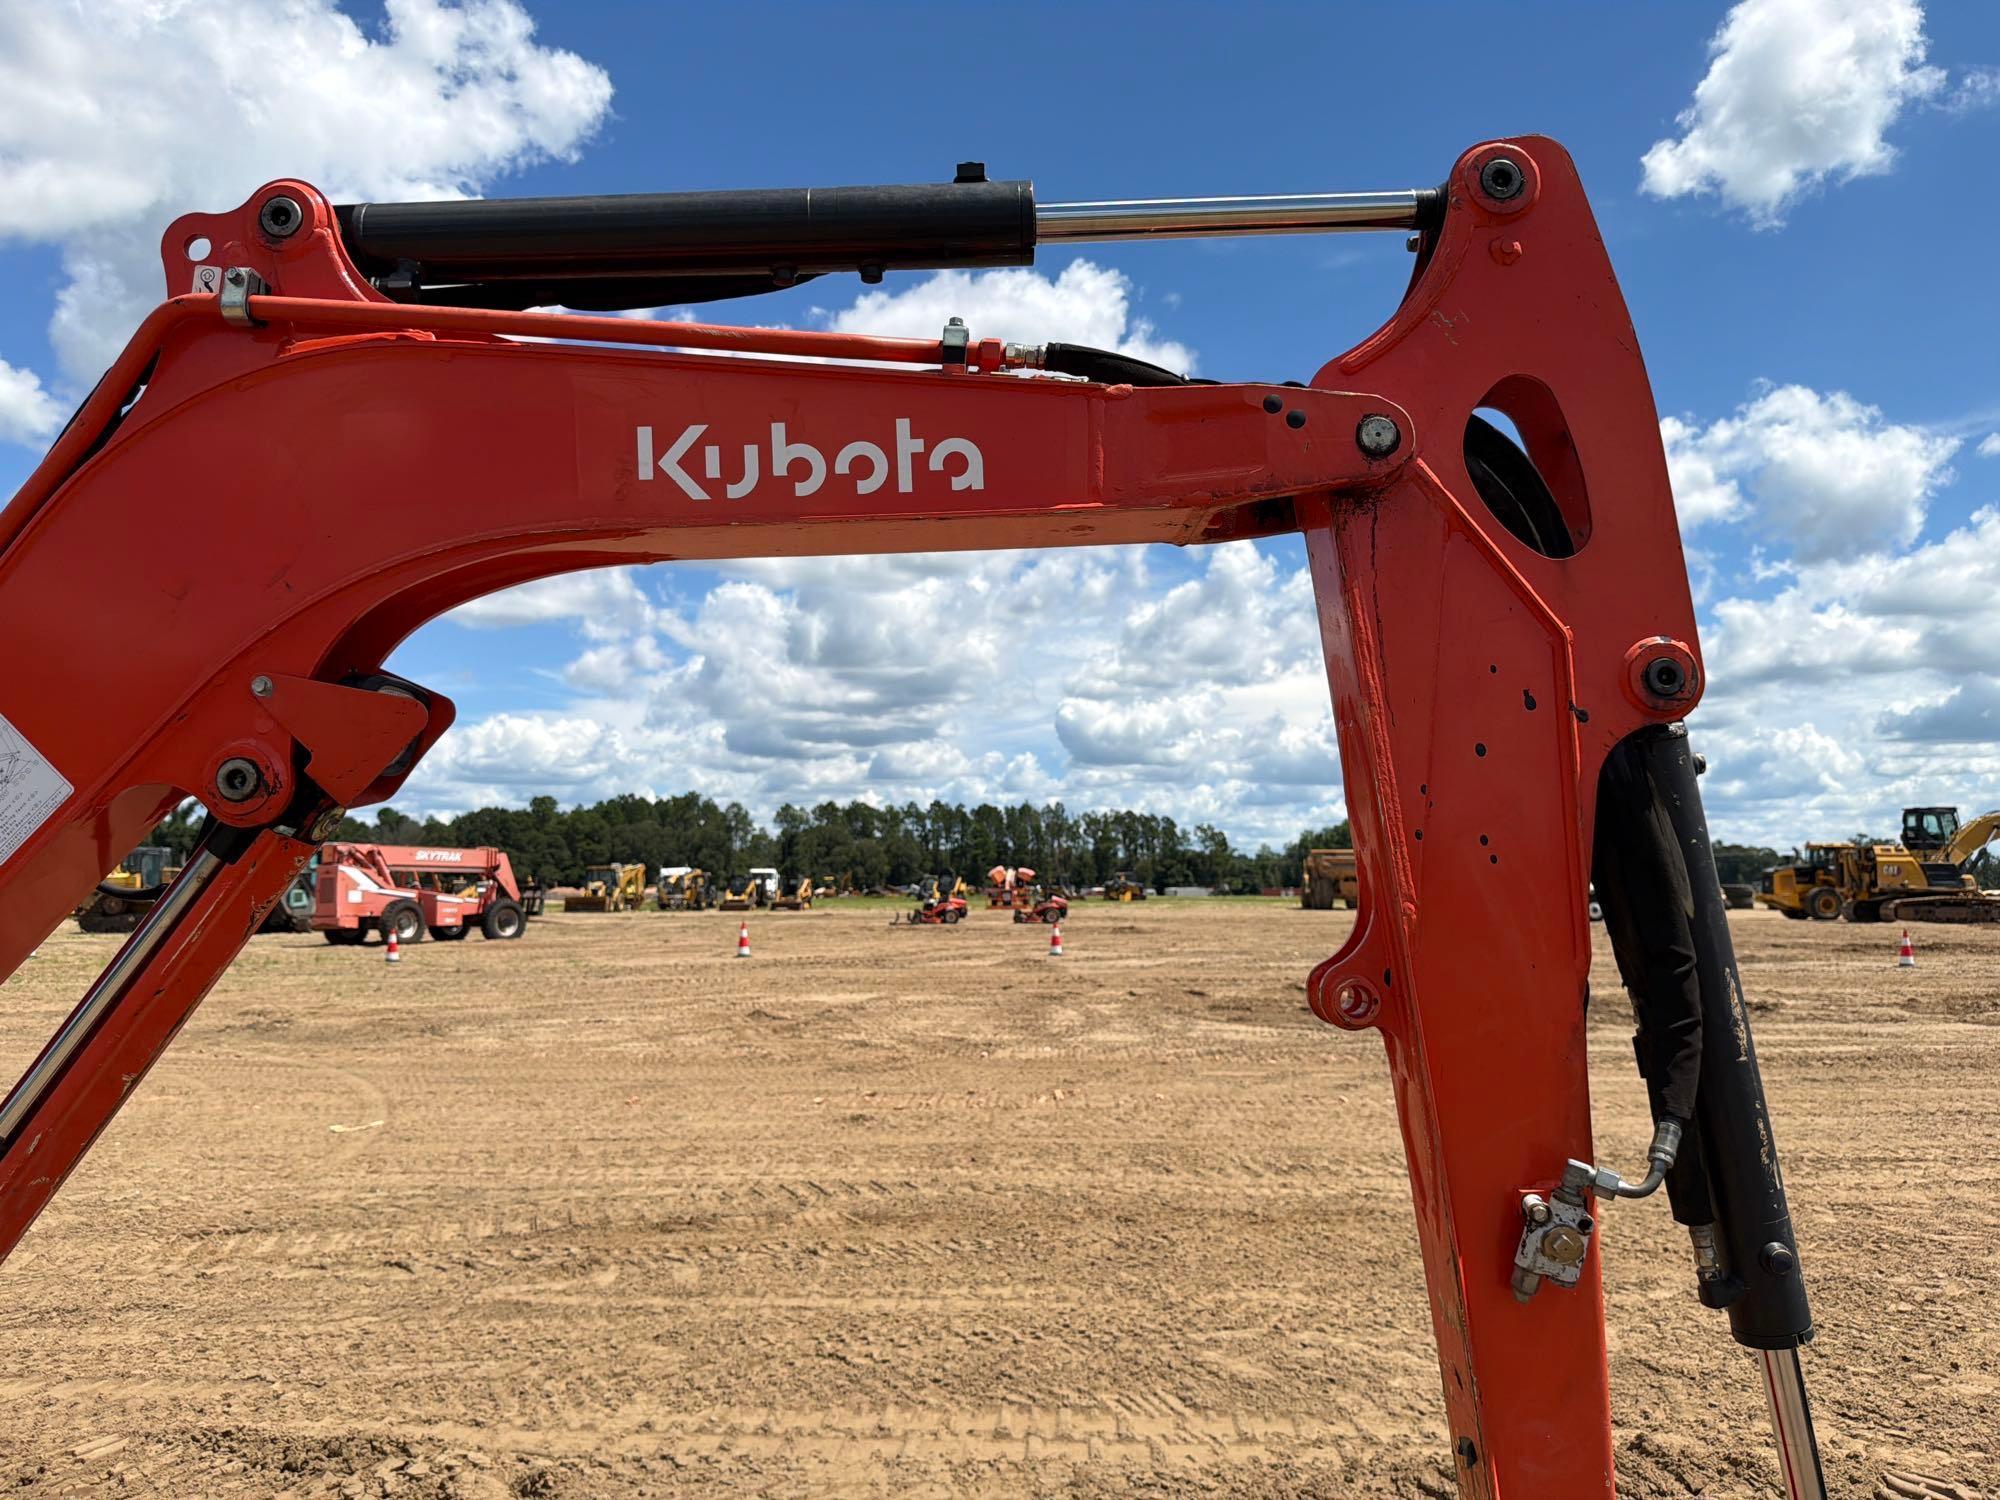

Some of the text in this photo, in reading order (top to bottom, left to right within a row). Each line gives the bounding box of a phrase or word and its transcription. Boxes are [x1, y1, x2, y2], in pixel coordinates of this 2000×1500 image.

[637, 418, 984, 500] Kubota
[415, 849, 463, 862] SKYTRAK
[1882, 864, 1899, 876] CAT
